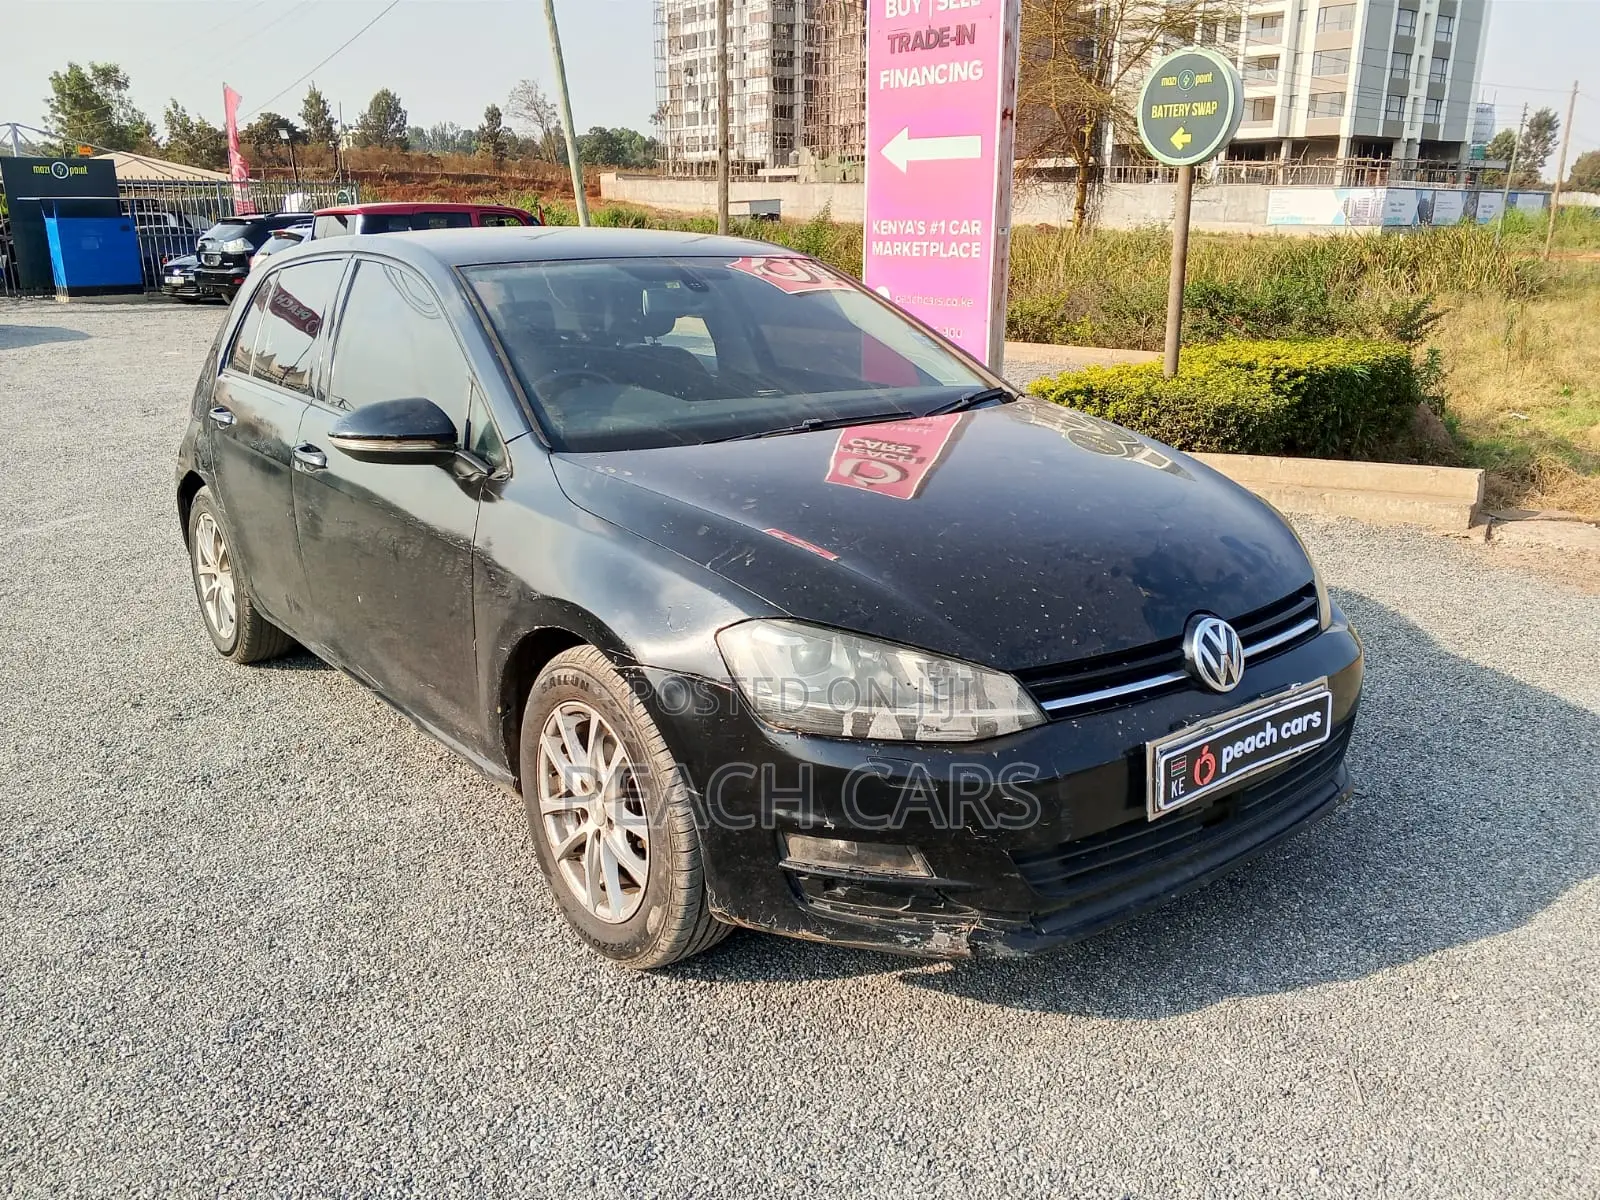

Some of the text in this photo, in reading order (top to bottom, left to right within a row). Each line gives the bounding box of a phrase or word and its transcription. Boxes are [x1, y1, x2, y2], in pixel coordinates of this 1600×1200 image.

[885, 0, 921, 19] BUY
[887, 23, 976, 54] TRADE-IN
[879, 60, 984, 90] FINANCING
[1151, 101, 1218, 119] BATTERY SWAP
[70, 165, 88, 177] point
[872, 220, 982, 236] KENYA'S #1 CAR
[871, 241, 981, 258] MARKETPLACE
[1221, 711, 1322, 773] peach cars
[1170, 776, 1186, 799] KE
